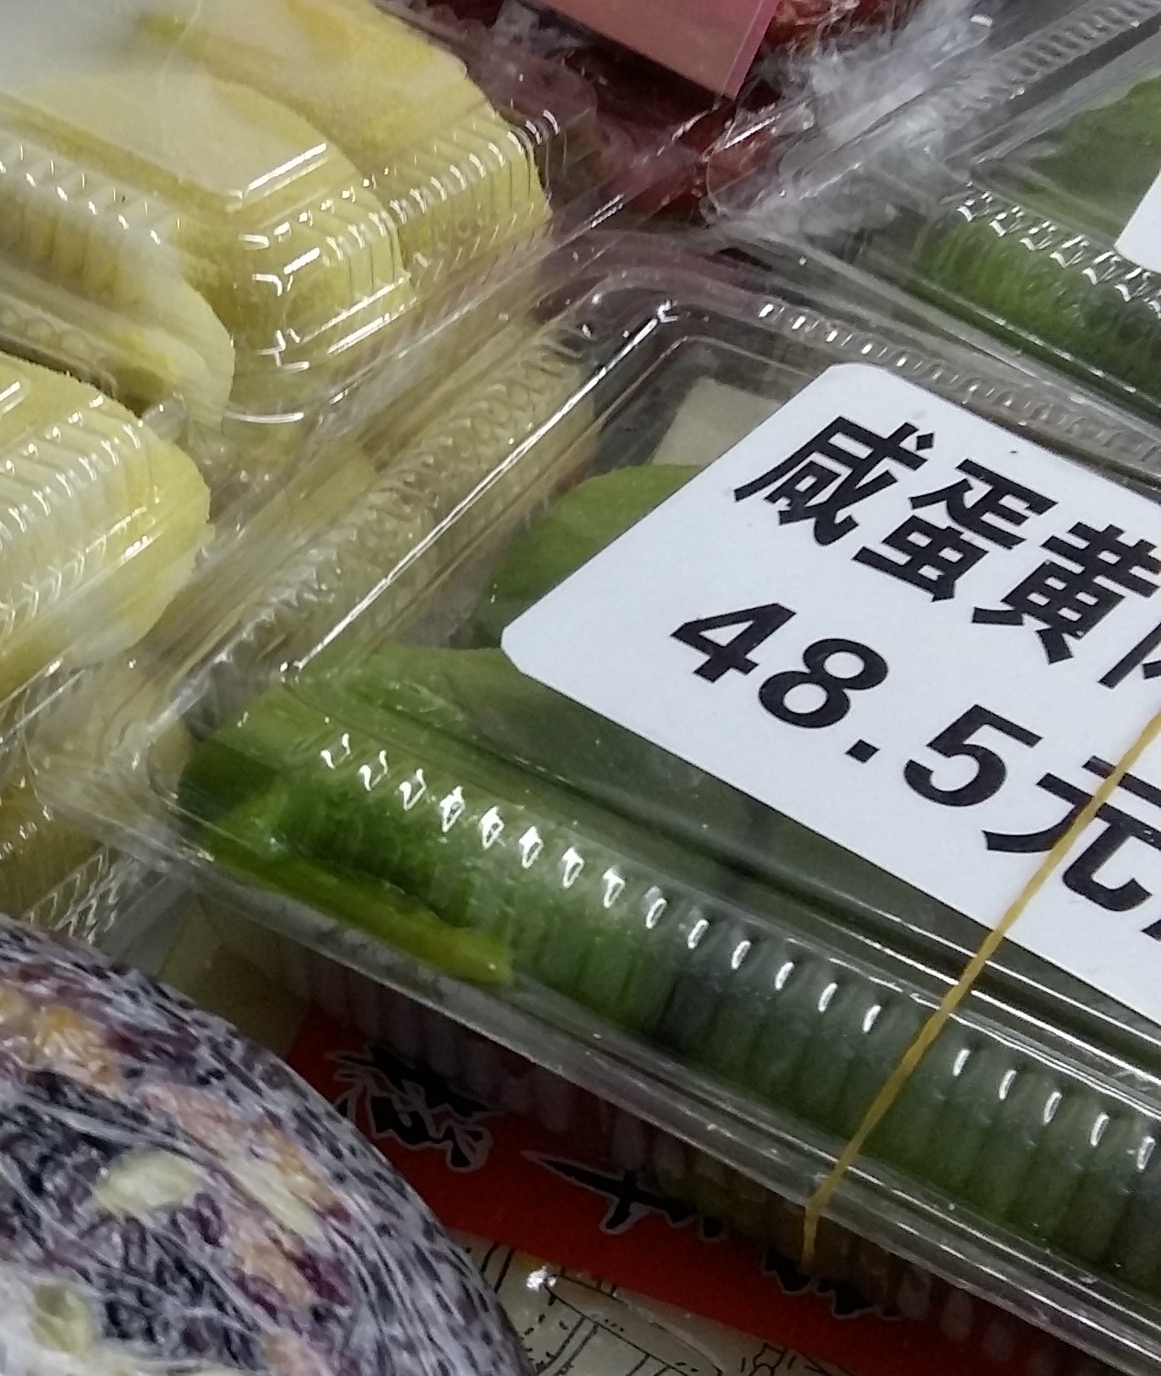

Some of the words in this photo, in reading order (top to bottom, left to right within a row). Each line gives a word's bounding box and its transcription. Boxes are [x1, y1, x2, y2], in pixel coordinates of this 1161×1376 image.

[734, 415, 1161, 688] 咸蛋黄
[669, 601, 1161, 941] 48.5元
